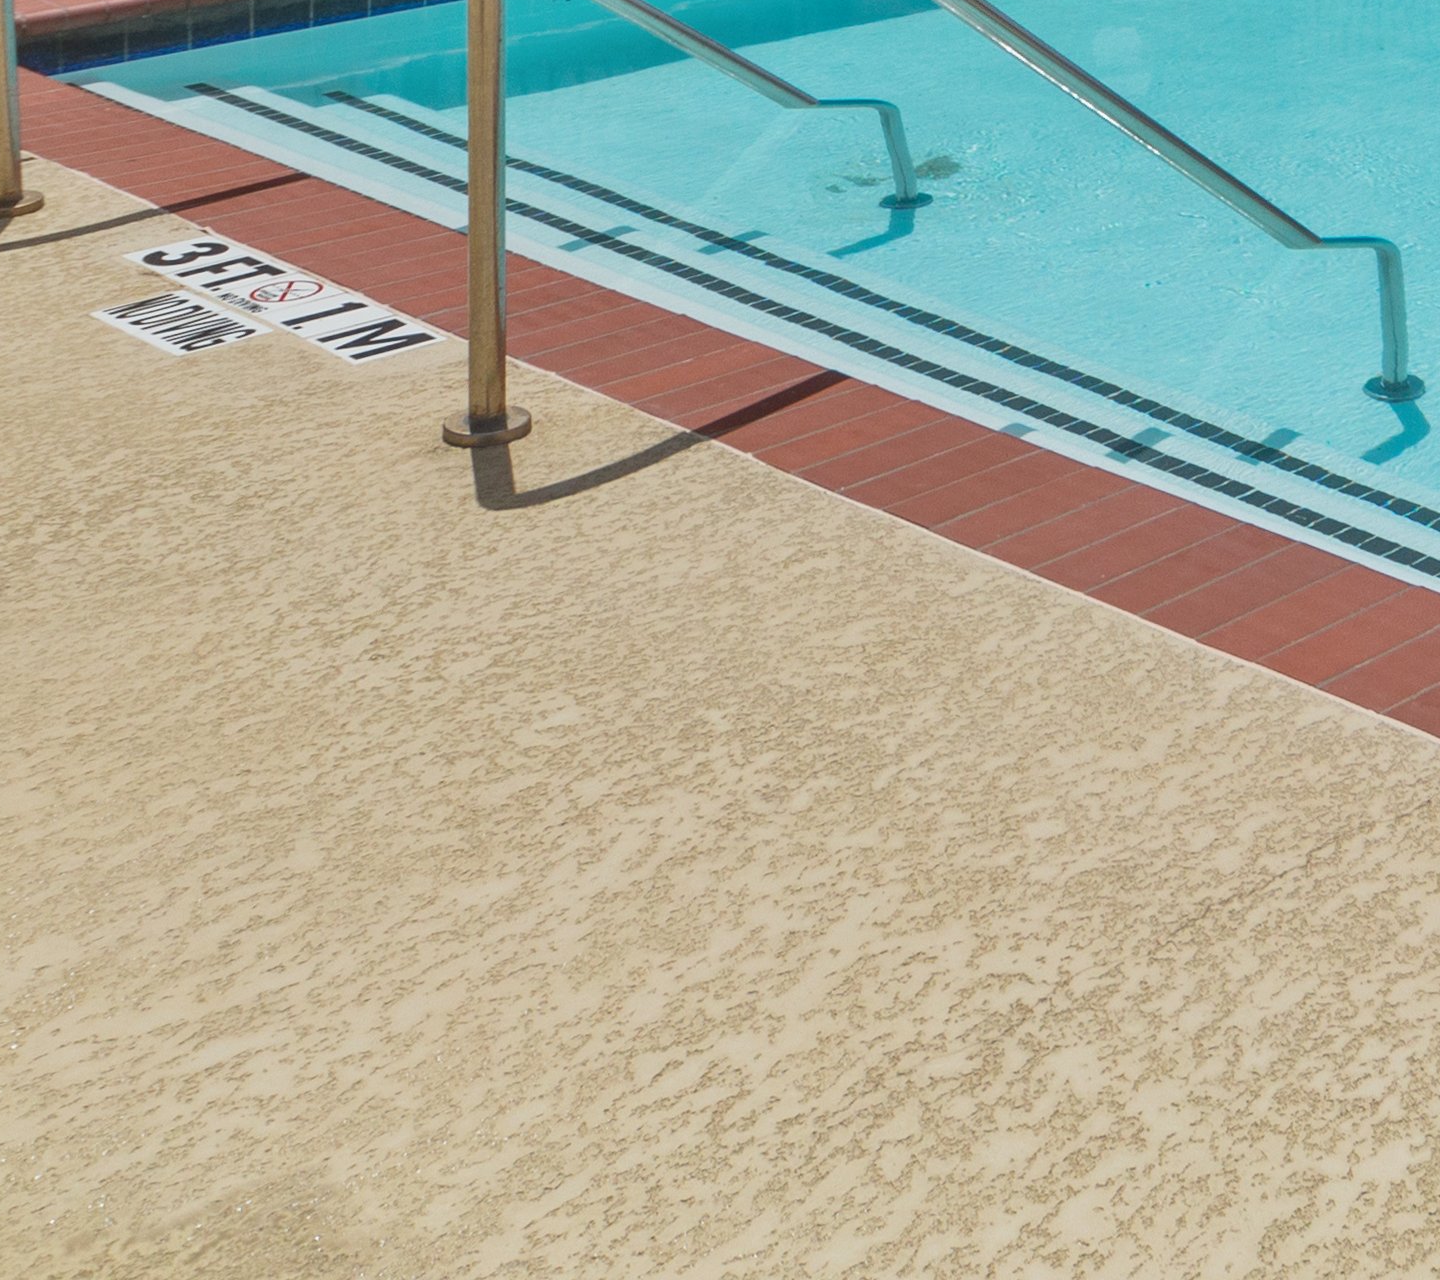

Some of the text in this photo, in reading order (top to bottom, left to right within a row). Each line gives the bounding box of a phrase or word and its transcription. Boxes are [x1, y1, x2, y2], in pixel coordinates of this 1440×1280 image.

[102, 293, 257, 352] NO DIVING
[142, 242, 229, 266] 3
[317, 319, 437, 360] M
